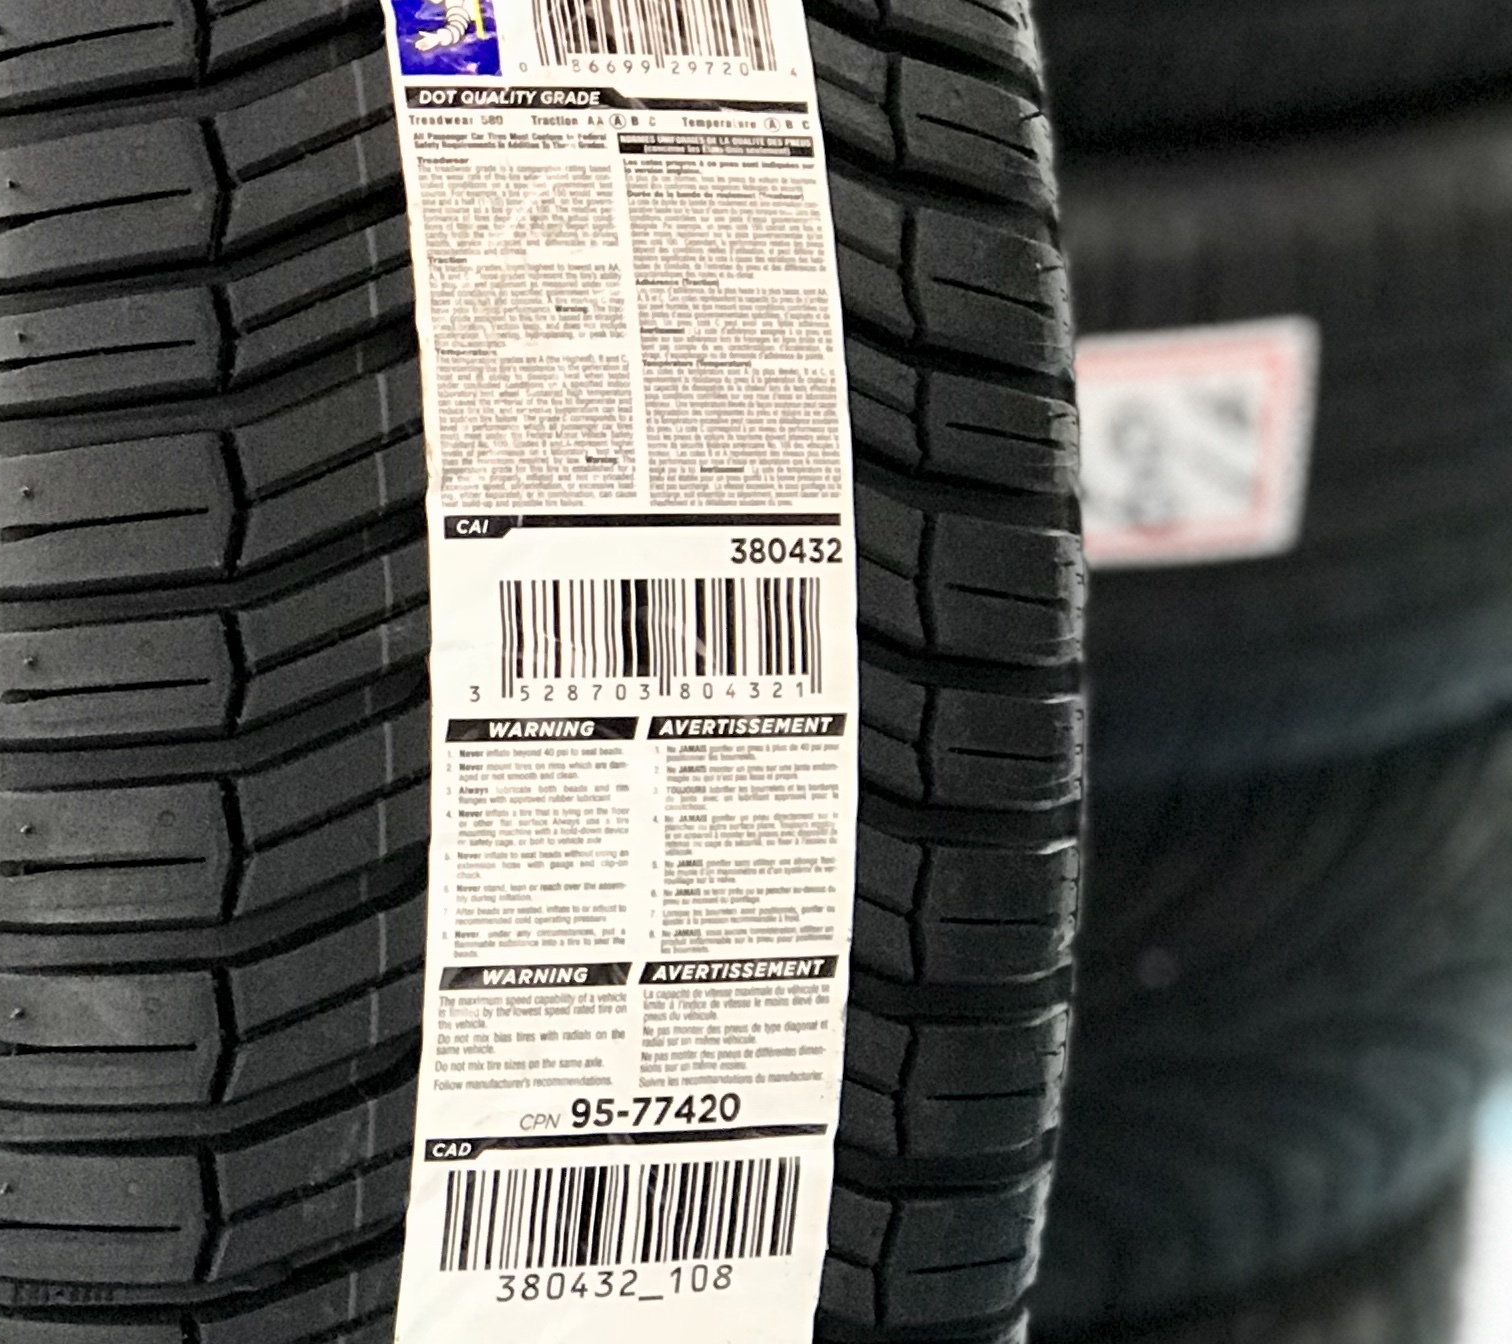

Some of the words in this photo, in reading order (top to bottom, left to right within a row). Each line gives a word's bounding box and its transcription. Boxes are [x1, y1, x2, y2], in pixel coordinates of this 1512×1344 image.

[418, 89, 457, 105] DOT
[460, 89, 536, 107] QUALITY
[540, 91, 600, 107] GRADE
[531, 115, 578, 125] Traction
[682, 117, 756, 129] Temperaure
[456, 519, 489, 535] CAI
[731, 537, 843, 564] 380432
[470, 686, 480, 702] 3
[519, 682, 651, 701] 528703
[679, 681, 804, 700] 804321
[490, 721, 594, 737] WARNING
[659, 717, 833, 735] AVERTISSEMENT
[482, 967, 590, 985] WARNING
[652, 959, 826, 981] AVERTISSEMENT
[520, 1114, 560, 1130] CPN
[570, 1093, 741, 1129] 95-77420
[433, 1143, 471, 1157] CAD
[496, 1264, 734, 1302] 380432_108
